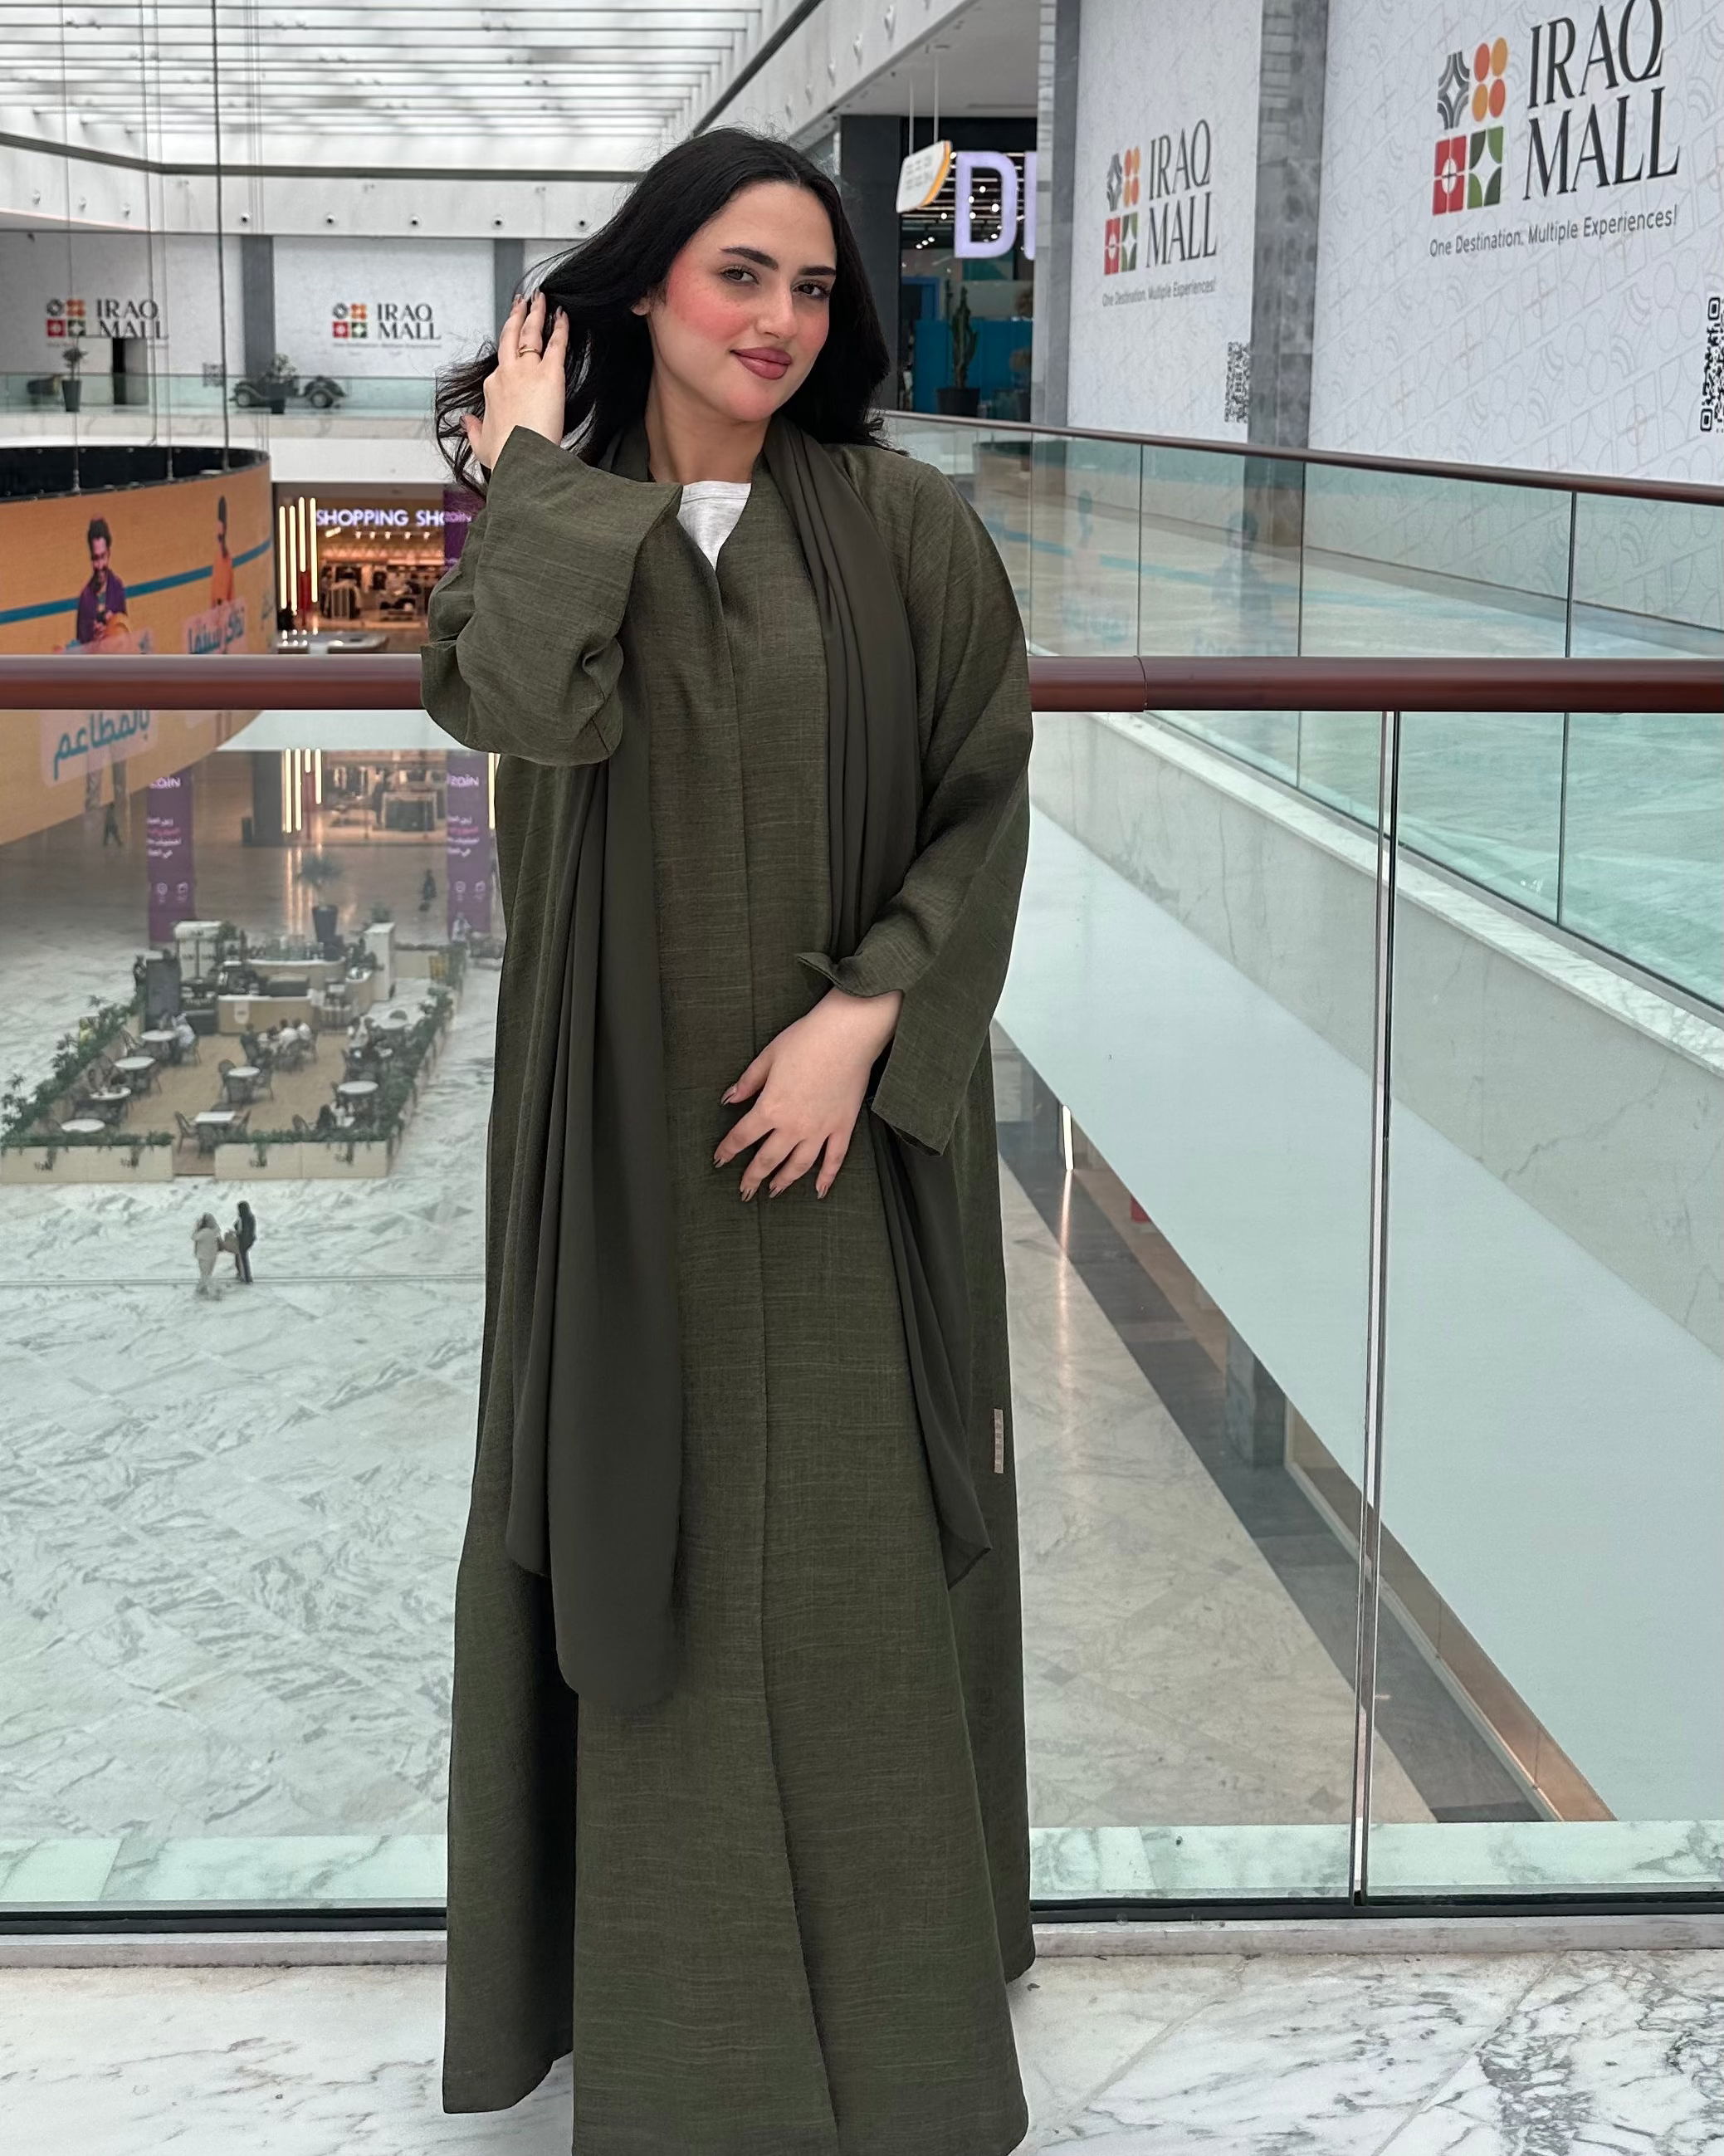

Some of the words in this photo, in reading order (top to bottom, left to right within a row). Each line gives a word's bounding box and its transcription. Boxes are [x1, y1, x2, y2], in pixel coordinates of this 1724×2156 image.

[1526, 0, 1665, 110] IRAQ
[1148, 119, 1212, 202] IRAQ
[1522, 86, 1681, 201] MALL
[1145, 191, 1219, 268] MALL
[1429, 238, 1452, 257] One
[1455, 228, 1525, 254] Destination.
[1527, 218, 1579, 246] Multiple
[1583, 203, 1678, 239] Experiences!
[96, 298, 160, 320] IRAQ
[98, 319, 169, 340] MALL
[377, 301, 434, 322] IRAQ
[377, 321, 442, 340] MALL
[316, 508, 409, 526] SHOPPING
[53, 709, 150, 781] بالمطاعم
